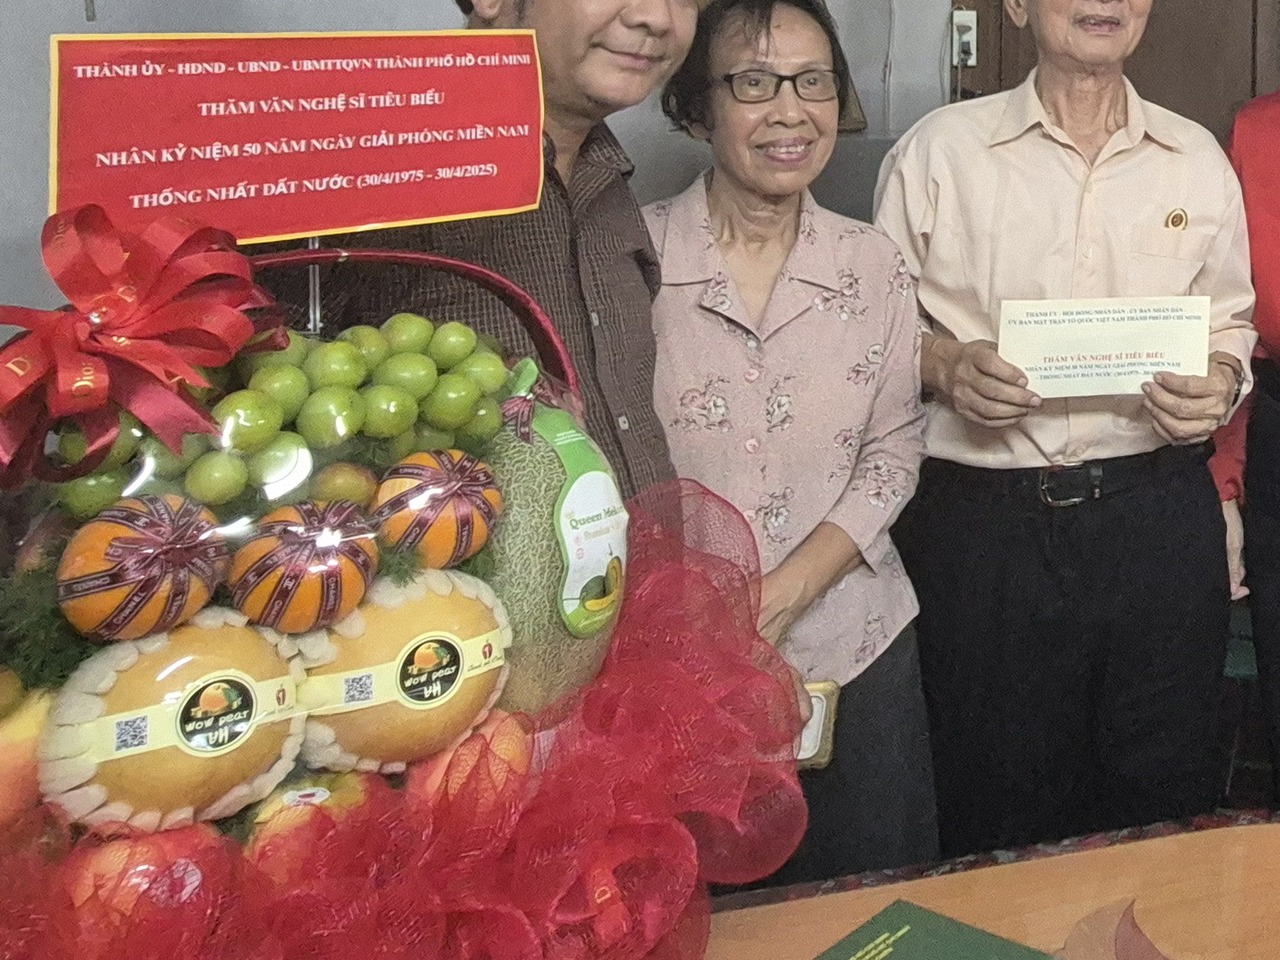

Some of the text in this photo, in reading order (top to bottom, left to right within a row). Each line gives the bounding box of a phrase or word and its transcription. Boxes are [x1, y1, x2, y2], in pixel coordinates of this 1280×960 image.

[73, 62, 138, 78] THÀNH
[141, 60, 166, 76] ỦY
[177, 62, 226, 76] HĐND
[237, 60, 281, 73] UBND
[292, 58, 372, 72] UBMTTQVN
[374, 55, 423, 69] THÀNH
[425, 54, 454, 68] PHỐ
[456, 52, 475, 67] HỒ
[477, 53, 499, 66] CHÍ
[502, 54, 531, 65] MINH
[197, 98, 255, 116] THĂM
[259, 96, 294, 113] VĂN
[298, 93, 346, 113] NGHỆ
[348, 92, 366, 109] SĨ
[368, 91, 407, 107] TIÊU
[95, 124, 529, 167] NHÂN KỶ NIỆM 50 NĂM NGÀY GIẢI PHÓNG MIỀN NAM
[129, 187, 202, 209] THỐNG
[206, 181, 260, 202] NHẤT
[262, 177, 299, 197] ĐẤT
[302, 173, 355, 193] NƯỚC
[357, 168, 424, 189] (30/4/1975
[436, 163, 498, 179] 30/4/2025)
[569, 513, 602, 530] Queen
[112, 590, 147, 626] CHANEL
[432, 665, 457, 681] pear
[218, 709, 250, 727] pear
